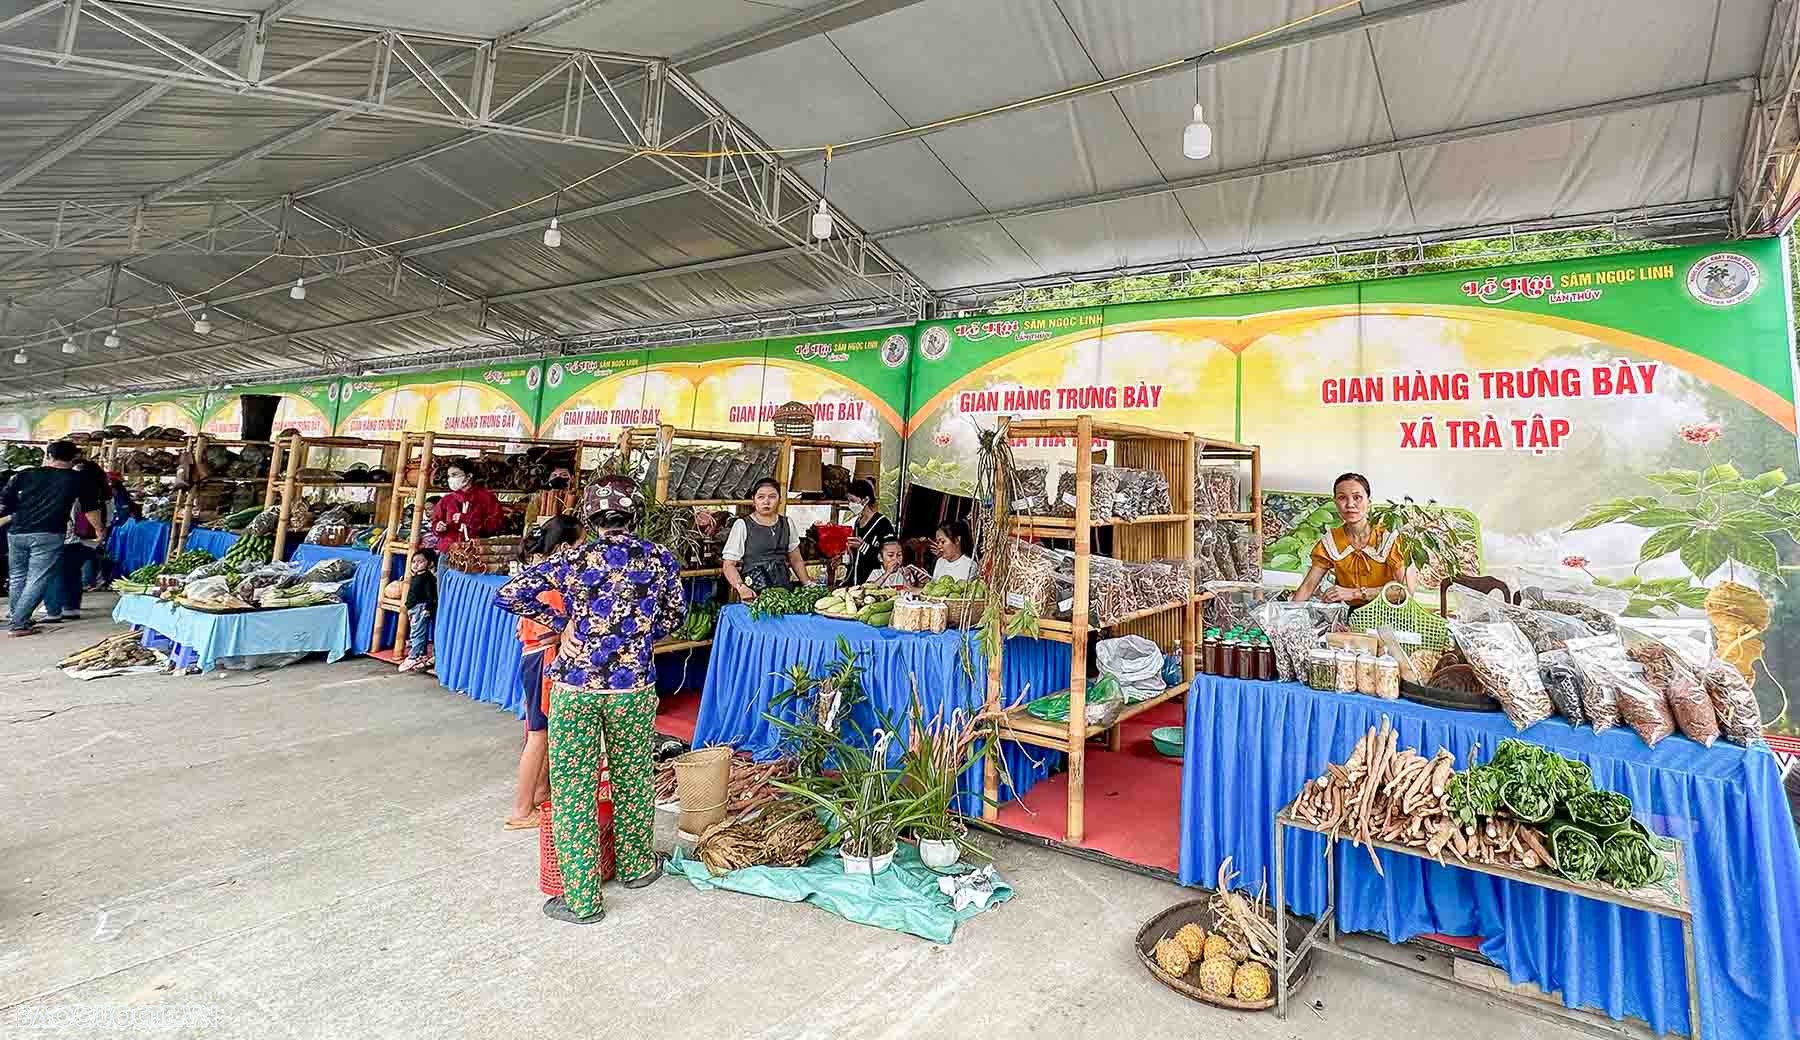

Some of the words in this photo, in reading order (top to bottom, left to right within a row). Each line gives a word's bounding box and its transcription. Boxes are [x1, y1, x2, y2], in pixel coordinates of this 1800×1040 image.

[1501, 274, 1554, 298] Hội
[1560, 271, 1592, 288] SÂM
[1596, 268, 1635, 286] NGỌC
[1640, 265, 1674, 281] LINH
[1024, 319, 1046, 330] SÂM
[1049, 316, 1077, 328] NGỌC
[1080, 314, 1103, 324] LINH
[960, 391, 998, 412] GIAN
[1004, 387, 1051, 411] HÀNG
[1056, 385, 1117, 409] TRƯNG
[1123, 381, 1162, 408] BÀY
[1321, 376, 1384, 404] GIAN
[1392, 370, 1469, 402] HÀNG
[1478, 367, 1581, 400] TRƯNG
[1592, 359, 1658, 396] BÀY
[564, 411, 584, 425] GIAN
[584, 408, 608, 425] HÀNG
[610, 408, 639, 424] TRƯNG
[641, 406, 660, 424] BÀY
[729, 406, 756, 422] GIAN
[838, 399, 863, 421] BÀY
[1400, 416, 1438, 449] XÃ
[1446, 415, 1503, 449] TRÀ
[1511, 414, 1571, 455] TẬP
